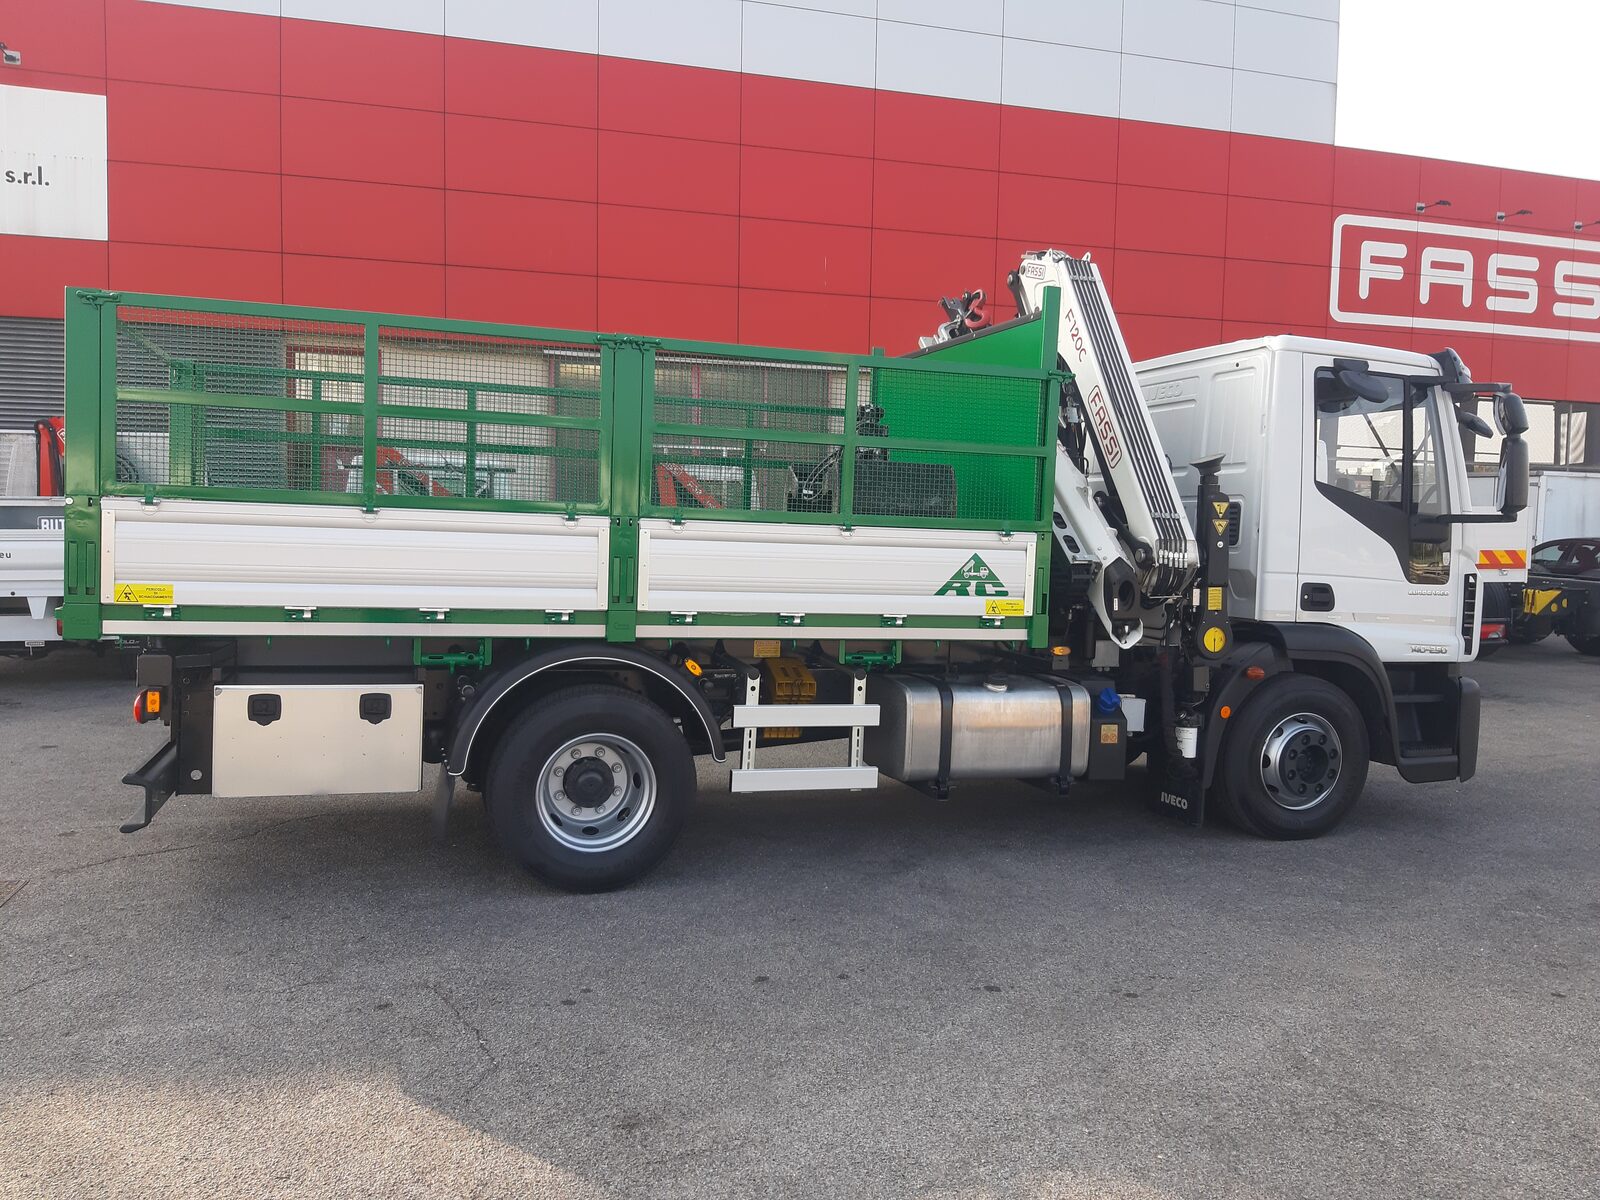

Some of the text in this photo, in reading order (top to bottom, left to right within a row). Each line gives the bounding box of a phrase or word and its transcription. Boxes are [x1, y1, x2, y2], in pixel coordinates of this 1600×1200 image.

[5, 166, 50, 186] s.r.l.
[1027, 265, 1045, 277] FASSI
[1065, 308, 1087, 362] F120C
[1090, 392, 1120, 462] FASSI
[1160, 791, 1188, 810] IVECO
